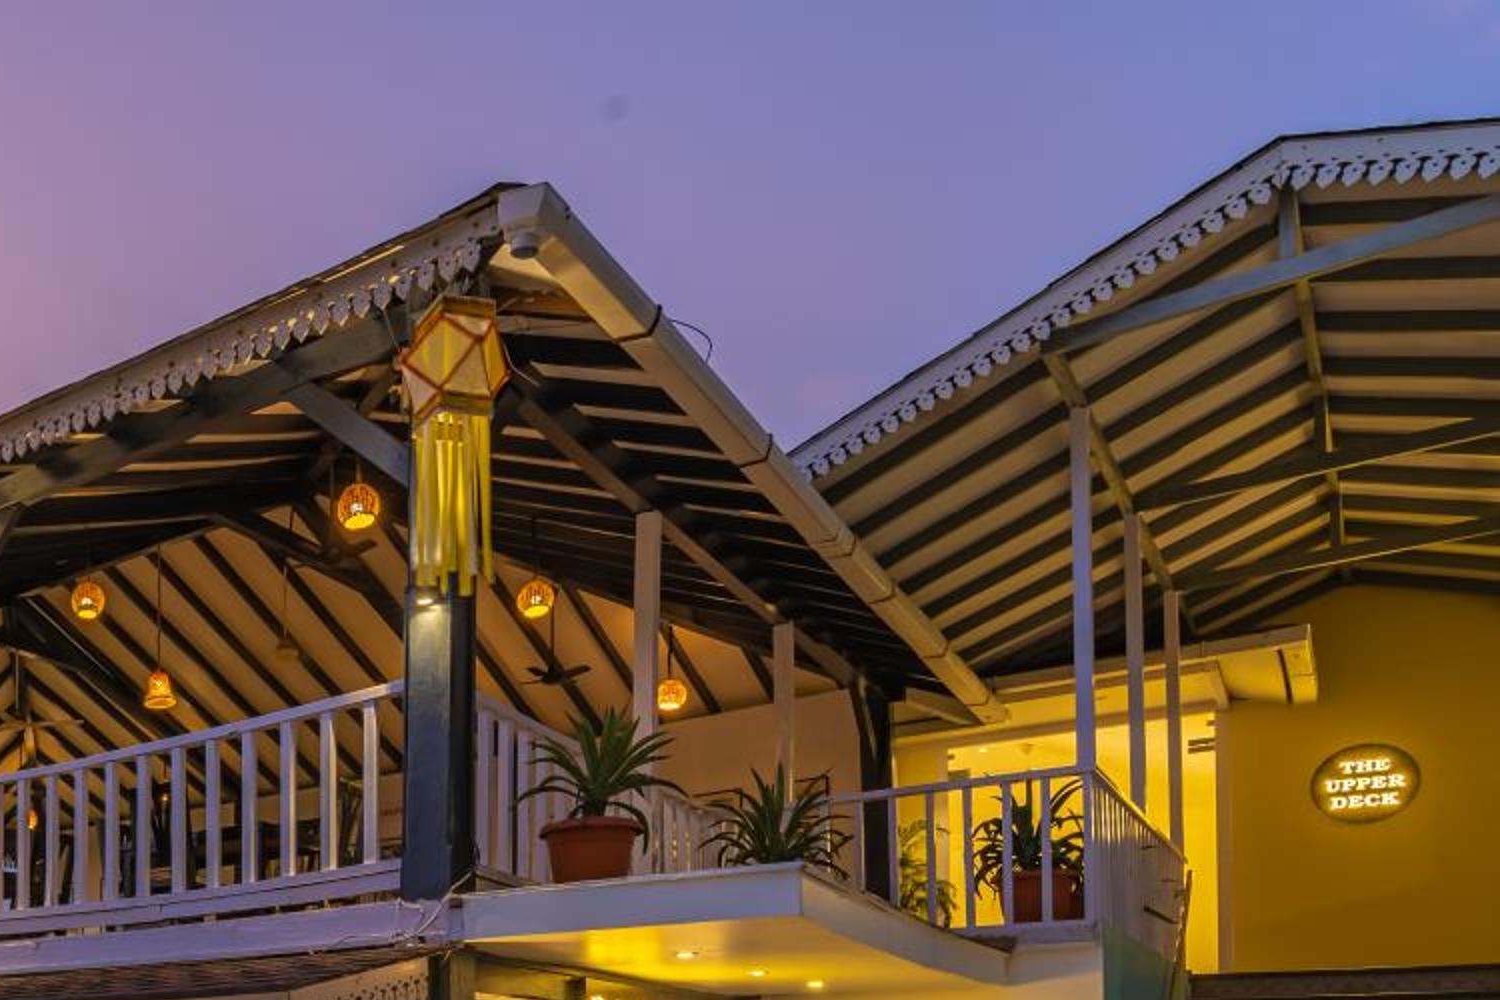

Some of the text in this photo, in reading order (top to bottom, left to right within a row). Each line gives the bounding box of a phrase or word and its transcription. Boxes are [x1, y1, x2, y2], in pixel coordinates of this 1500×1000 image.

[1339, 758, 1392, 775] THE
[1325, 774, 1406, 793] UPPER
[1330, 791, 1400, 810] DECK
